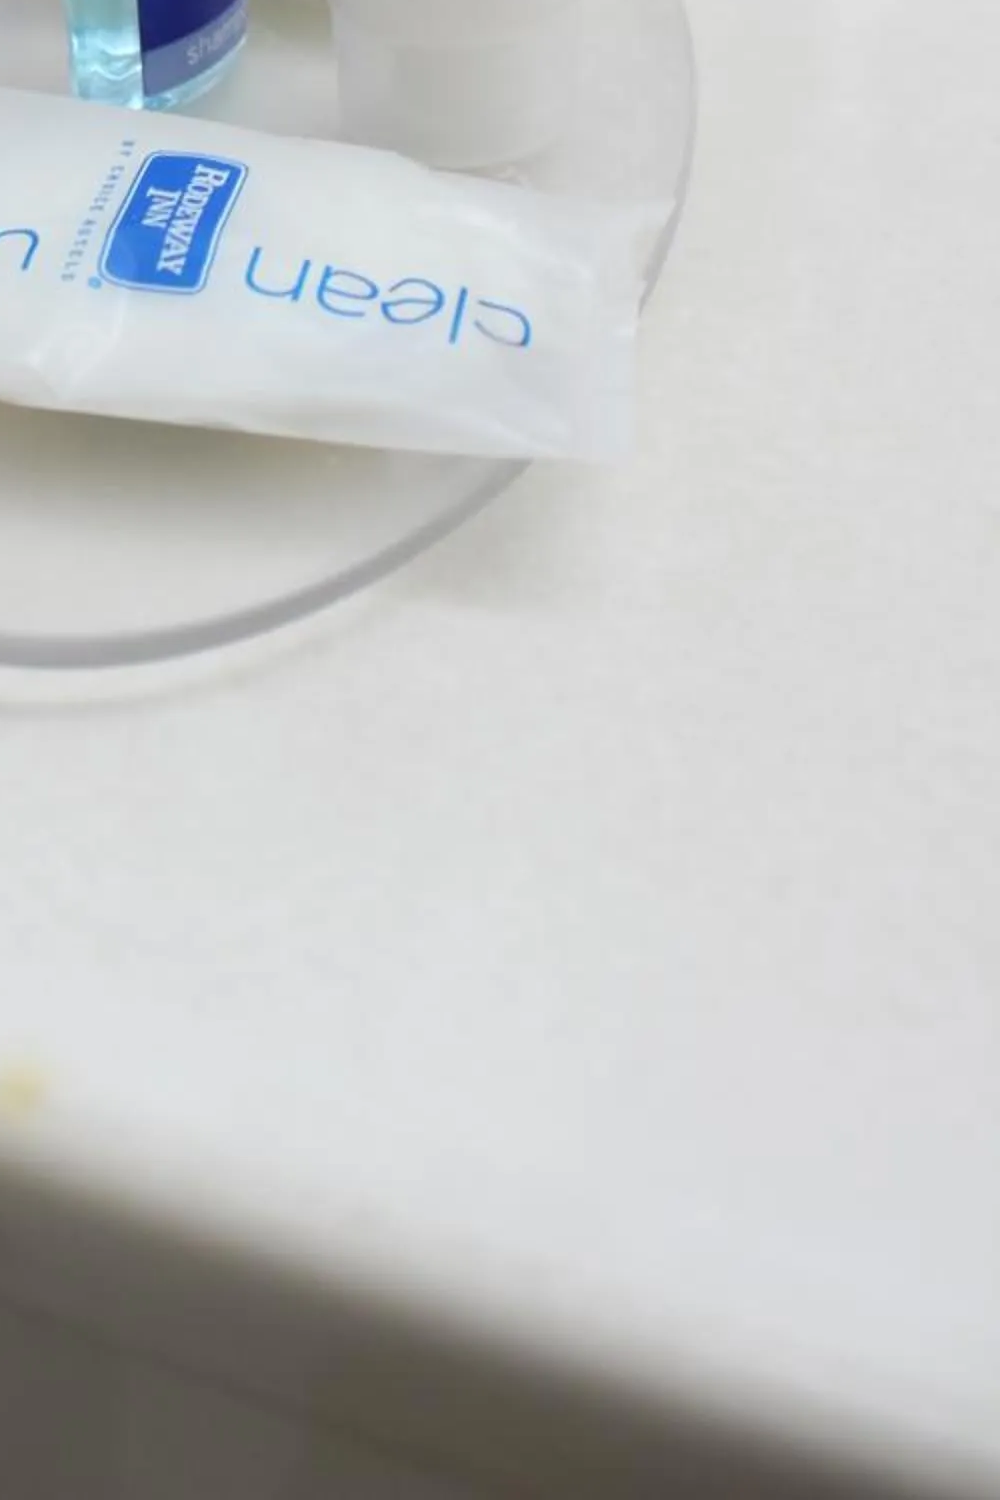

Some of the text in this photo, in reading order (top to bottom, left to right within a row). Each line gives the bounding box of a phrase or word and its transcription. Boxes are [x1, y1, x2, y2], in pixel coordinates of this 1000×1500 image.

[141, 186, 183, 229] INN
[155, 162, 231, 277] RODEWAY
[244, 246, 532, 348] clean
